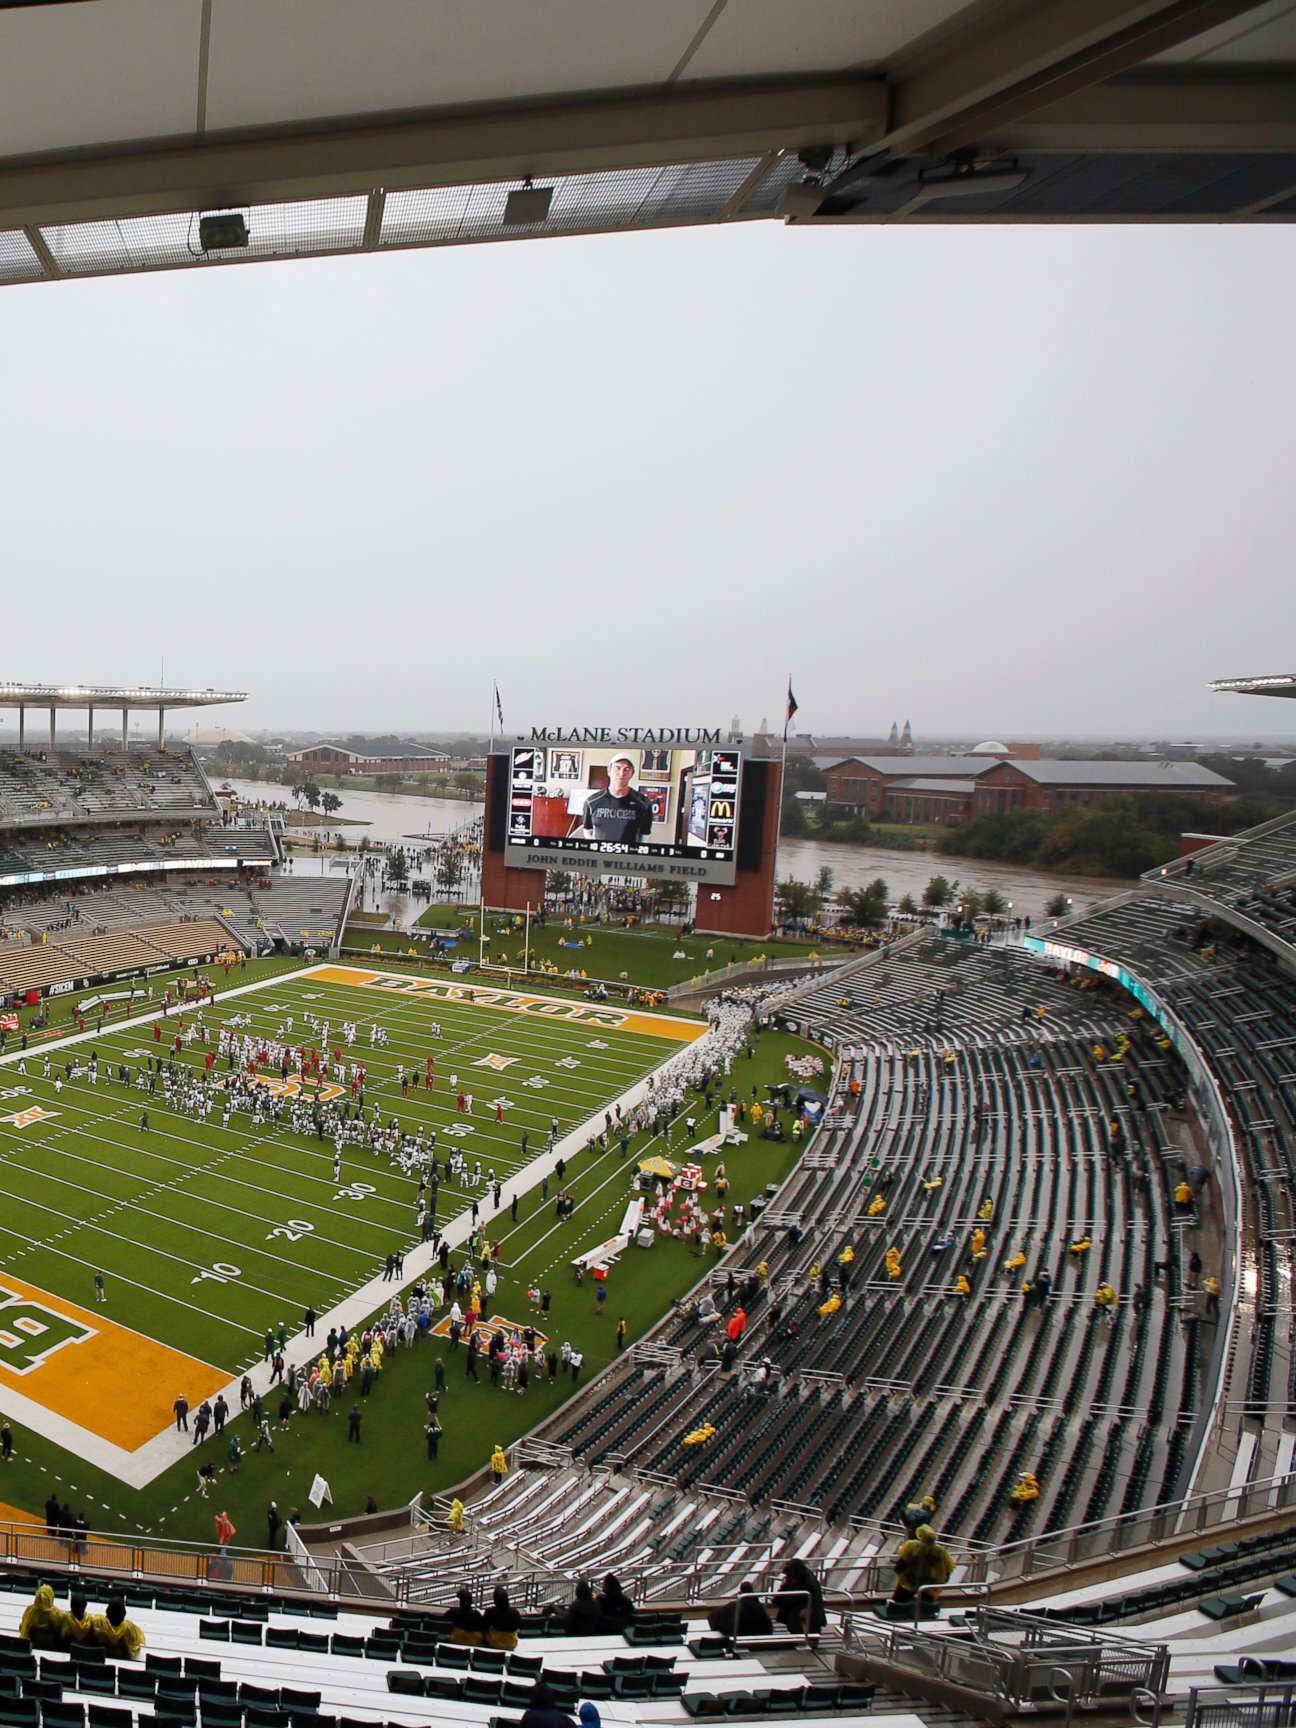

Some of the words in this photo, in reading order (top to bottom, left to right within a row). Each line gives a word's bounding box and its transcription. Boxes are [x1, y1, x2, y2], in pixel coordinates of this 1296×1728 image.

[530, 727, 611, 742] McLANE
[617, 727, 722, 744] STADIUM
[600, 842, 629, 854] 26:54
[638, 846, 649, 854] 20
[527, 854, 558, 864] JOHN
[561, 856, 598, 867] EDDIE
[603, 860, 664, 873] WILLIAMS
[669, 865, 707, 876] FIELD
[49, 981, 74, 995] #SICEM
[360, 976, 630, 1027] BAYLOR
[441, 1122, 475, 1138] 50
[338, 1182, 377, 1201] 30
[272, 1219, 315, 1242] 20
[200, 1262, 242, 1284] 10
